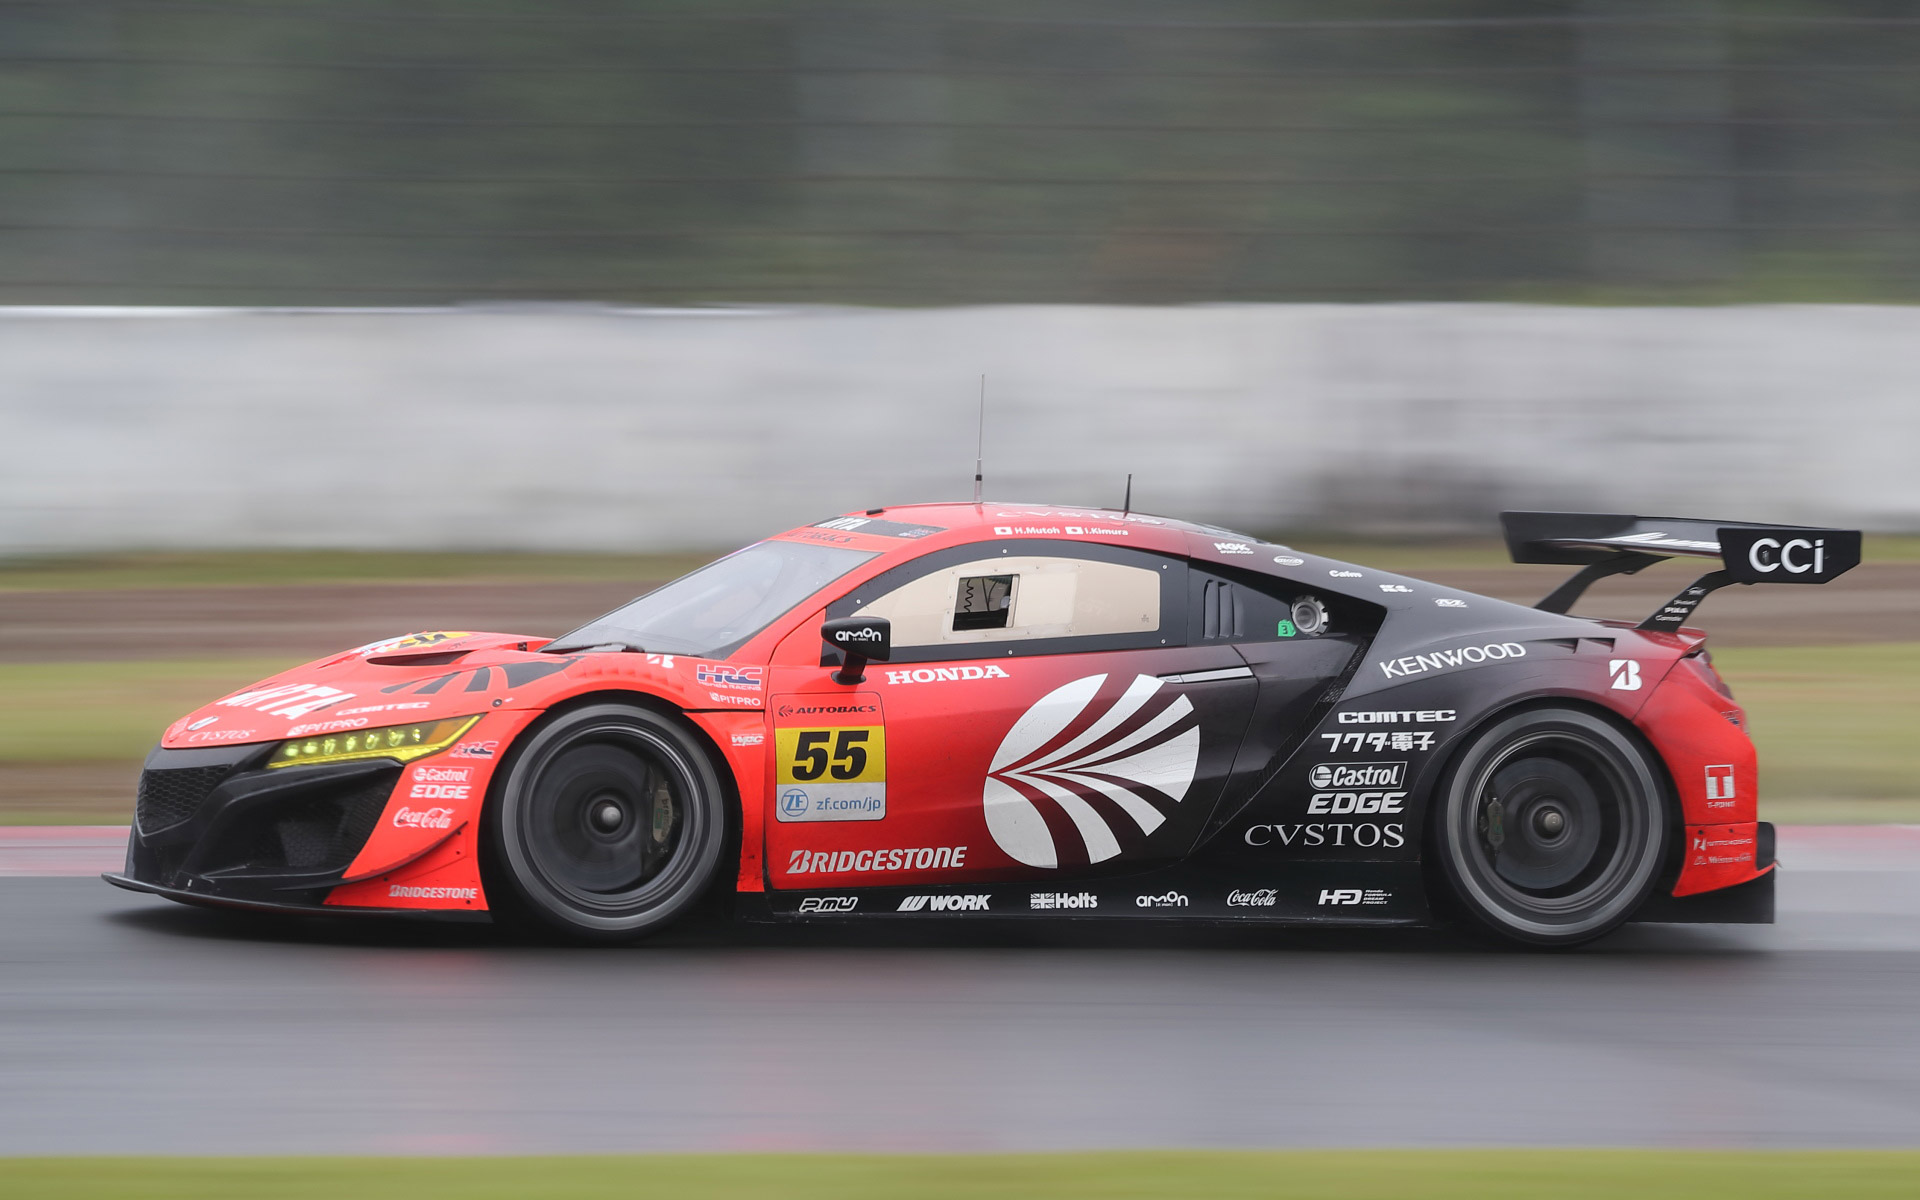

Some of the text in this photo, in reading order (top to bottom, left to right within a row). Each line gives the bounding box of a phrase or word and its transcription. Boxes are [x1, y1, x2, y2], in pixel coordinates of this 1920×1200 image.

[1014, 526, 1060, 535] H.Mutoh
[1084, 527, 1129, 536] I.Kimura
[1748, 537, 1825, 574] CCi
[835, 627, 882, 642] amon
[1378, 641, 1527, 680] KENWOOD
[696, 664, 763, 686] HRC
[885, 665, 1010, 685] HONDA
[719, 694, 761, 706] PITPRO
[796, 704, 877, 714] AUTOBACS
[1338, 709, 1457, 724] COMTEC
[303, 717, 369, 733] PITPRO
[791, 730, 870, 782] 55
[426, 768, 469, 782] Castrol
[1332, 765, 1399, 786] Castrol
[410, 784, 472, 799] EDGE
[782, 793, 808, 811] ZF
[816, 797, 881, 812] zf.com/jp
[1307, 791, 1408, 815] EDGE
[1244, 823, 1405, 848] CVSTOS
[786, 846, 968, 875] BRIDGESTONE
[388, 884, 478, 899] BRIDGESTONE
[1136, 891, 1189, 907] amon
[930, 895, 992, 911] WORK
[1055, 892, 1098, 909] Holts
